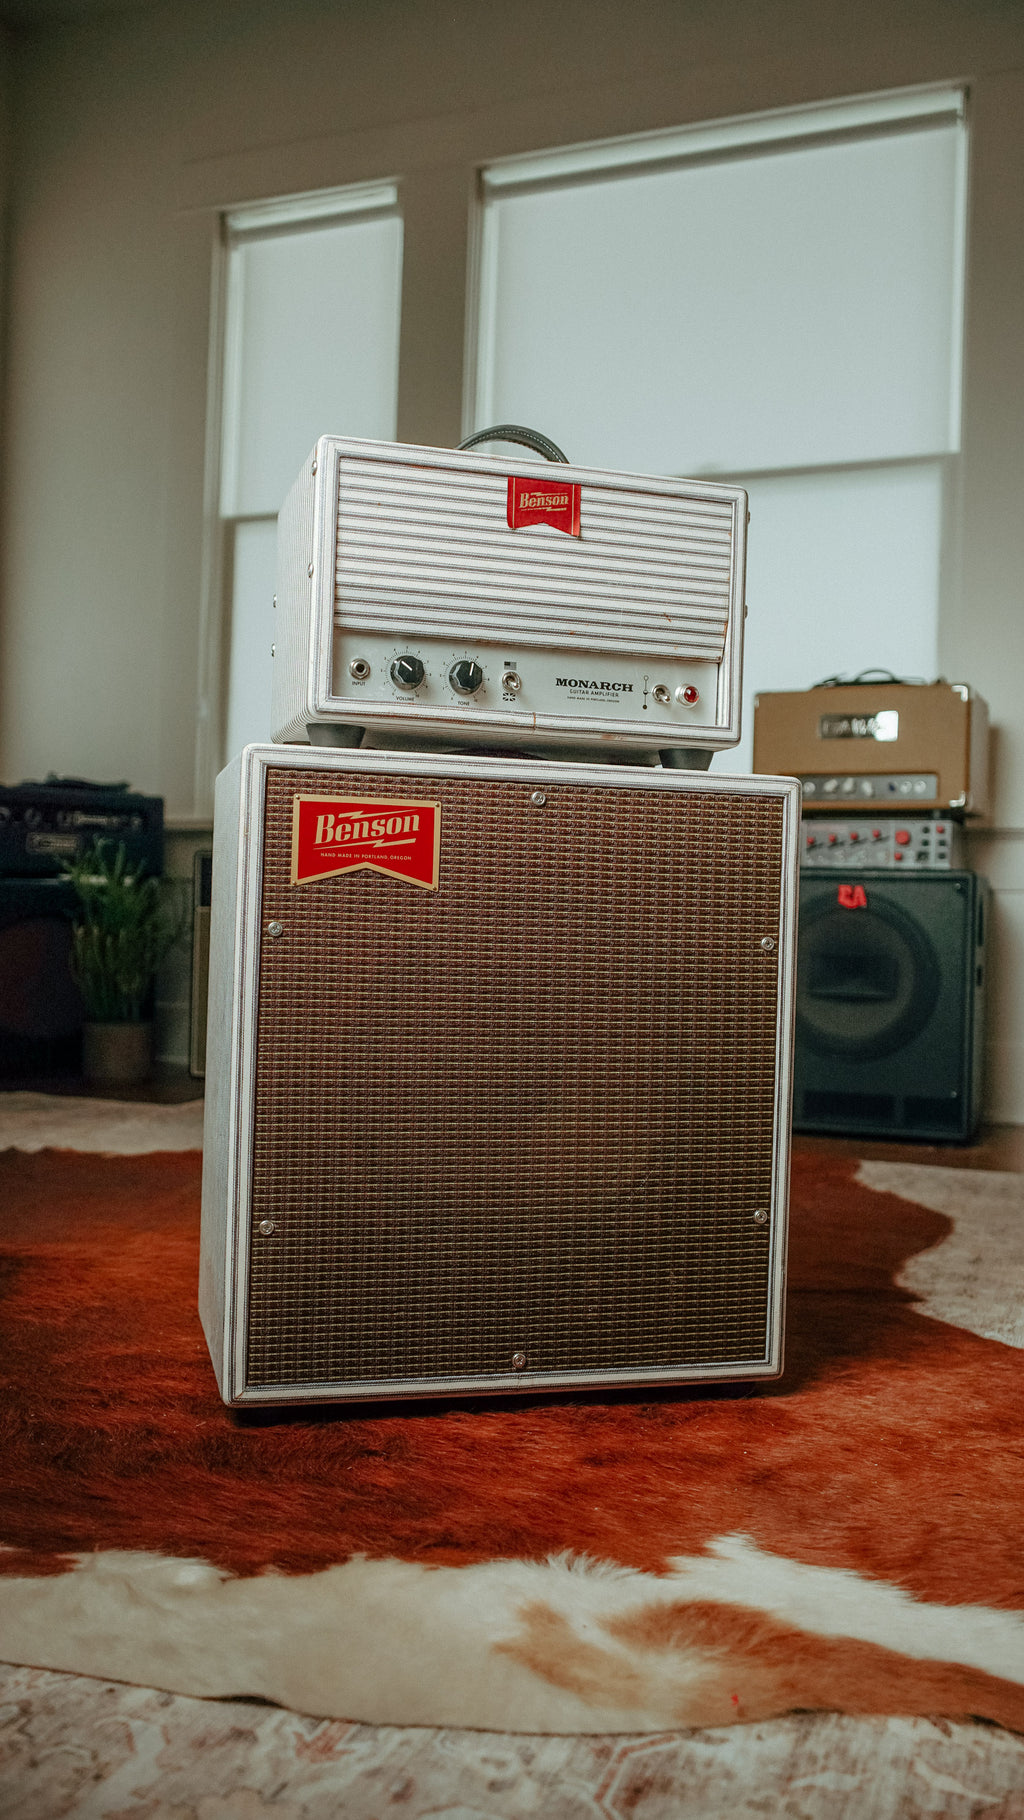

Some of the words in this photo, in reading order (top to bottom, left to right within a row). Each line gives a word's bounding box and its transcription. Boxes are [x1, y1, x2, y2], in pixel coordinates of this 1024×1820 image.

[519, 492, 569, 508] Benson
[555, 678, 634, 693] MONARCH
[590, 690, 619, 698] AMPLIFIER
[313, 814, 420, 845] Benson
